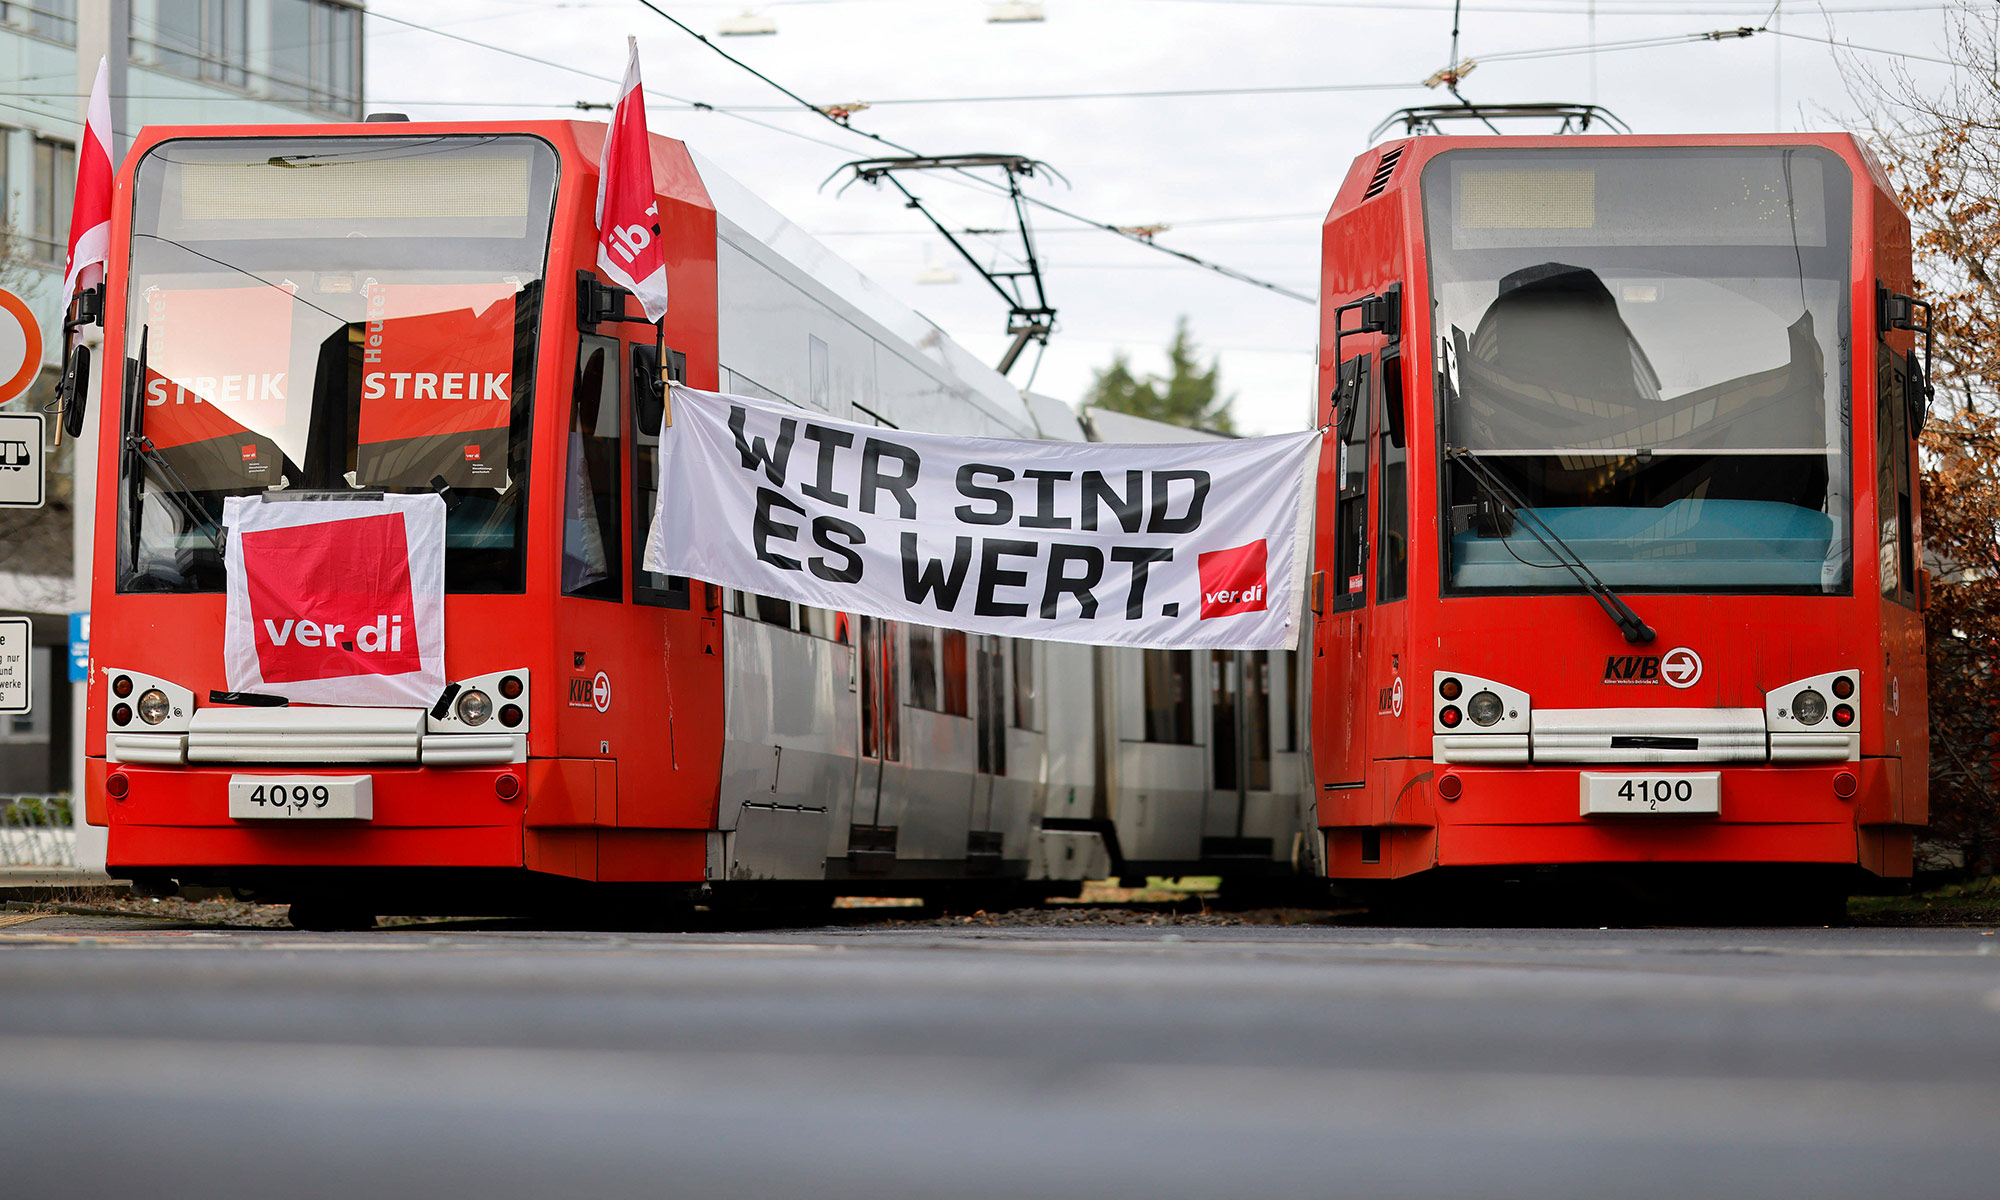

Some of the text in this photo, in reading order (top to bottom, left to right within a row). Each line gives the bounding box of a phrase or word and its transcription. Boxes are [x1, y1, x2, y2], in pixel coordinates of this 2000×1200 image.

[365, 286, 386, 363] Heute:
[147, 372, 287, 407] STREIK
[364, 372, 510, 401] STREIK
[727, 404, 1211, 534] WIR SIND
[753, 486, 1180, 621] ES WERT.
[1205, 585, 1262, 604] ver.di
[263, 614, 402, 652] ver.di
[1604, 656, 1660, 679] KVB
[569, 679, 593, 703] KVB
[1379, 687, 1393, 711] KVB
[250, 785, 329, 808] 4099
[1618, 780, 1693, 802] 4100
[286, 804, 292, 816] 1
[1650, 799, 1657, 811] 2
